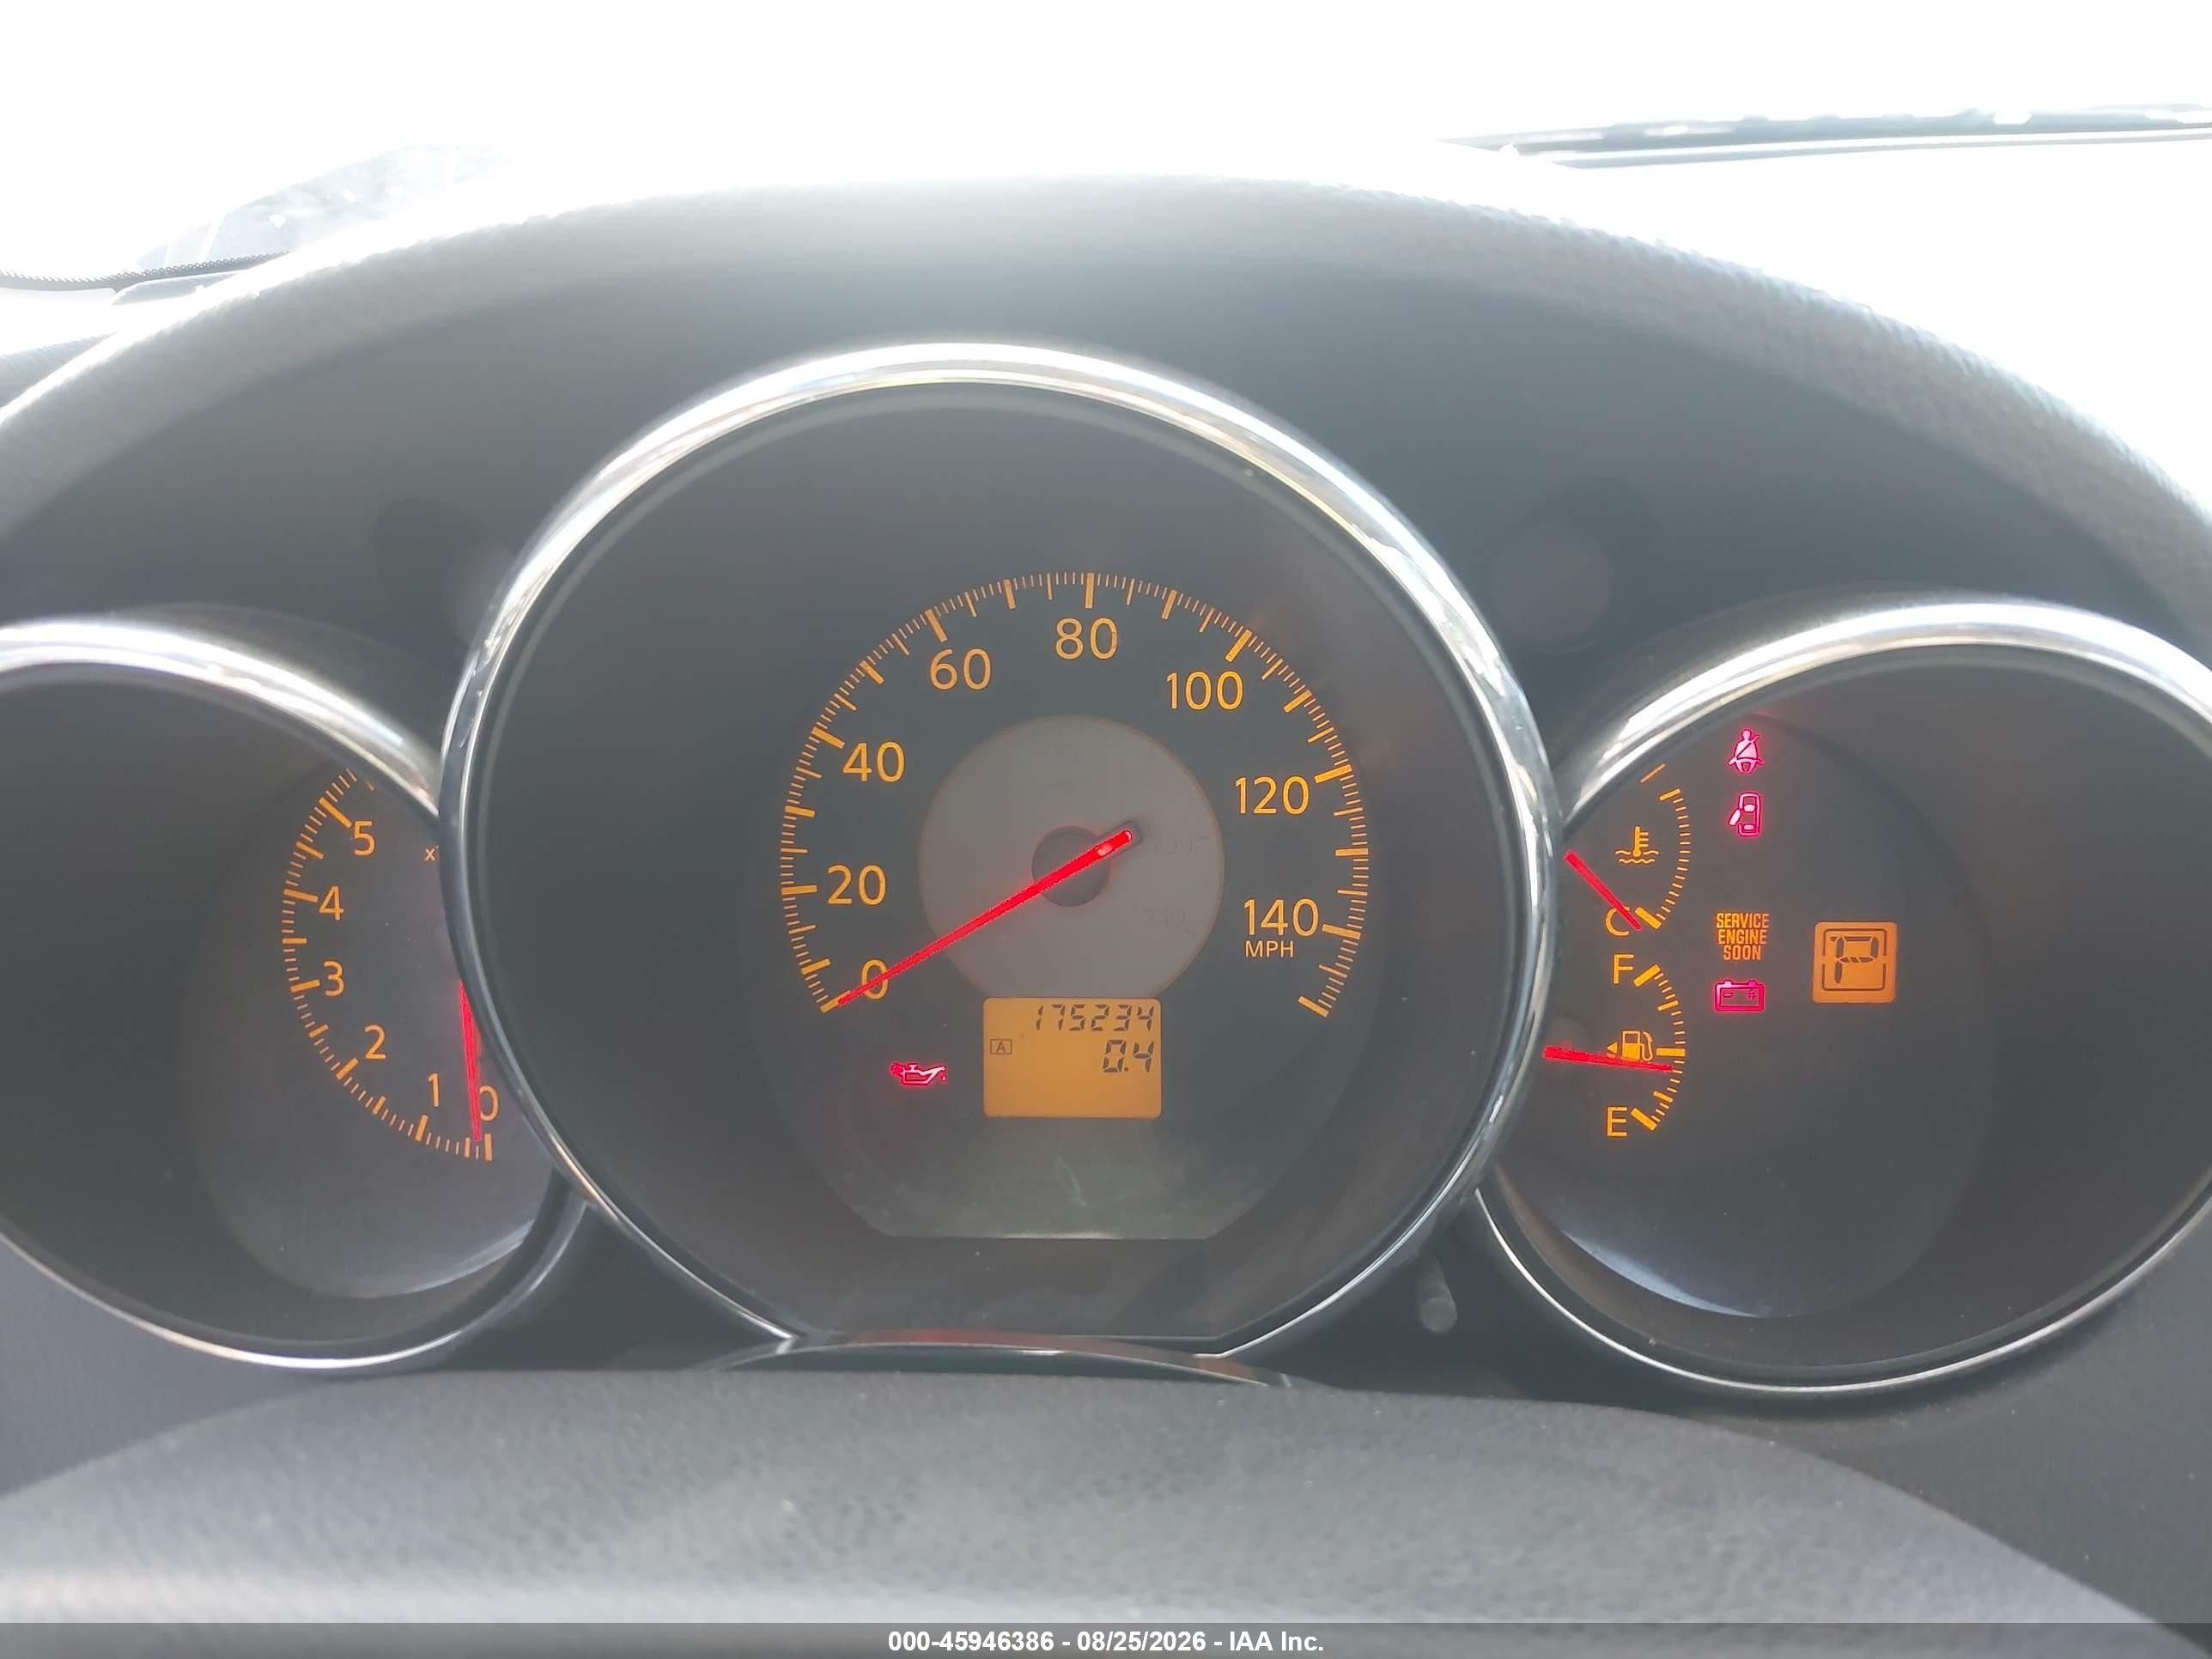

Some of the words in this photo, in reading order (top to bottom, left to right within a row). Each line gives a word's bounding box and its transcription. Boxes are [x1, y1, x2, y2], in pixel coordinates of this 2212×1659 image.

[1055, 619, 1118, 659] 80
[930, 649, 992, 690] 60
[1167, 672, 1244, 710] 100
[842, 741, 905, 783] 40
[1237, 776, 1310, 815] 120
[354, 820, 375, 856] 5
[319, 885, 344, 921] 4
[828, 866, 887, 905] 20
[1244, 898, 1320, 937] 140
[1605, 907, 1630, 937] C
[1716, 912, 1770, 928] SERVICE
[1245, 940, 1295, 957] MPH
[1717, 929, 1767, 945] ENGINE
[1723, 945, 1762, 962] SOON
[1613, 953, 1634, 985] F
[1830, 935, 1878, 983] P
[324, 960, 345, 997] 3
[860, 959, 890, 999] 0
[1036, 1004, 1154, 1030] 175234
[365, 1024, 386, 1061] 2
[1103, 1039, 1154, 1073] 0.4
[428, 1073, 440, 1107] 1
[475, 1085, 499, 1121] 0
[1607, 1106, 1628, 1137] E
